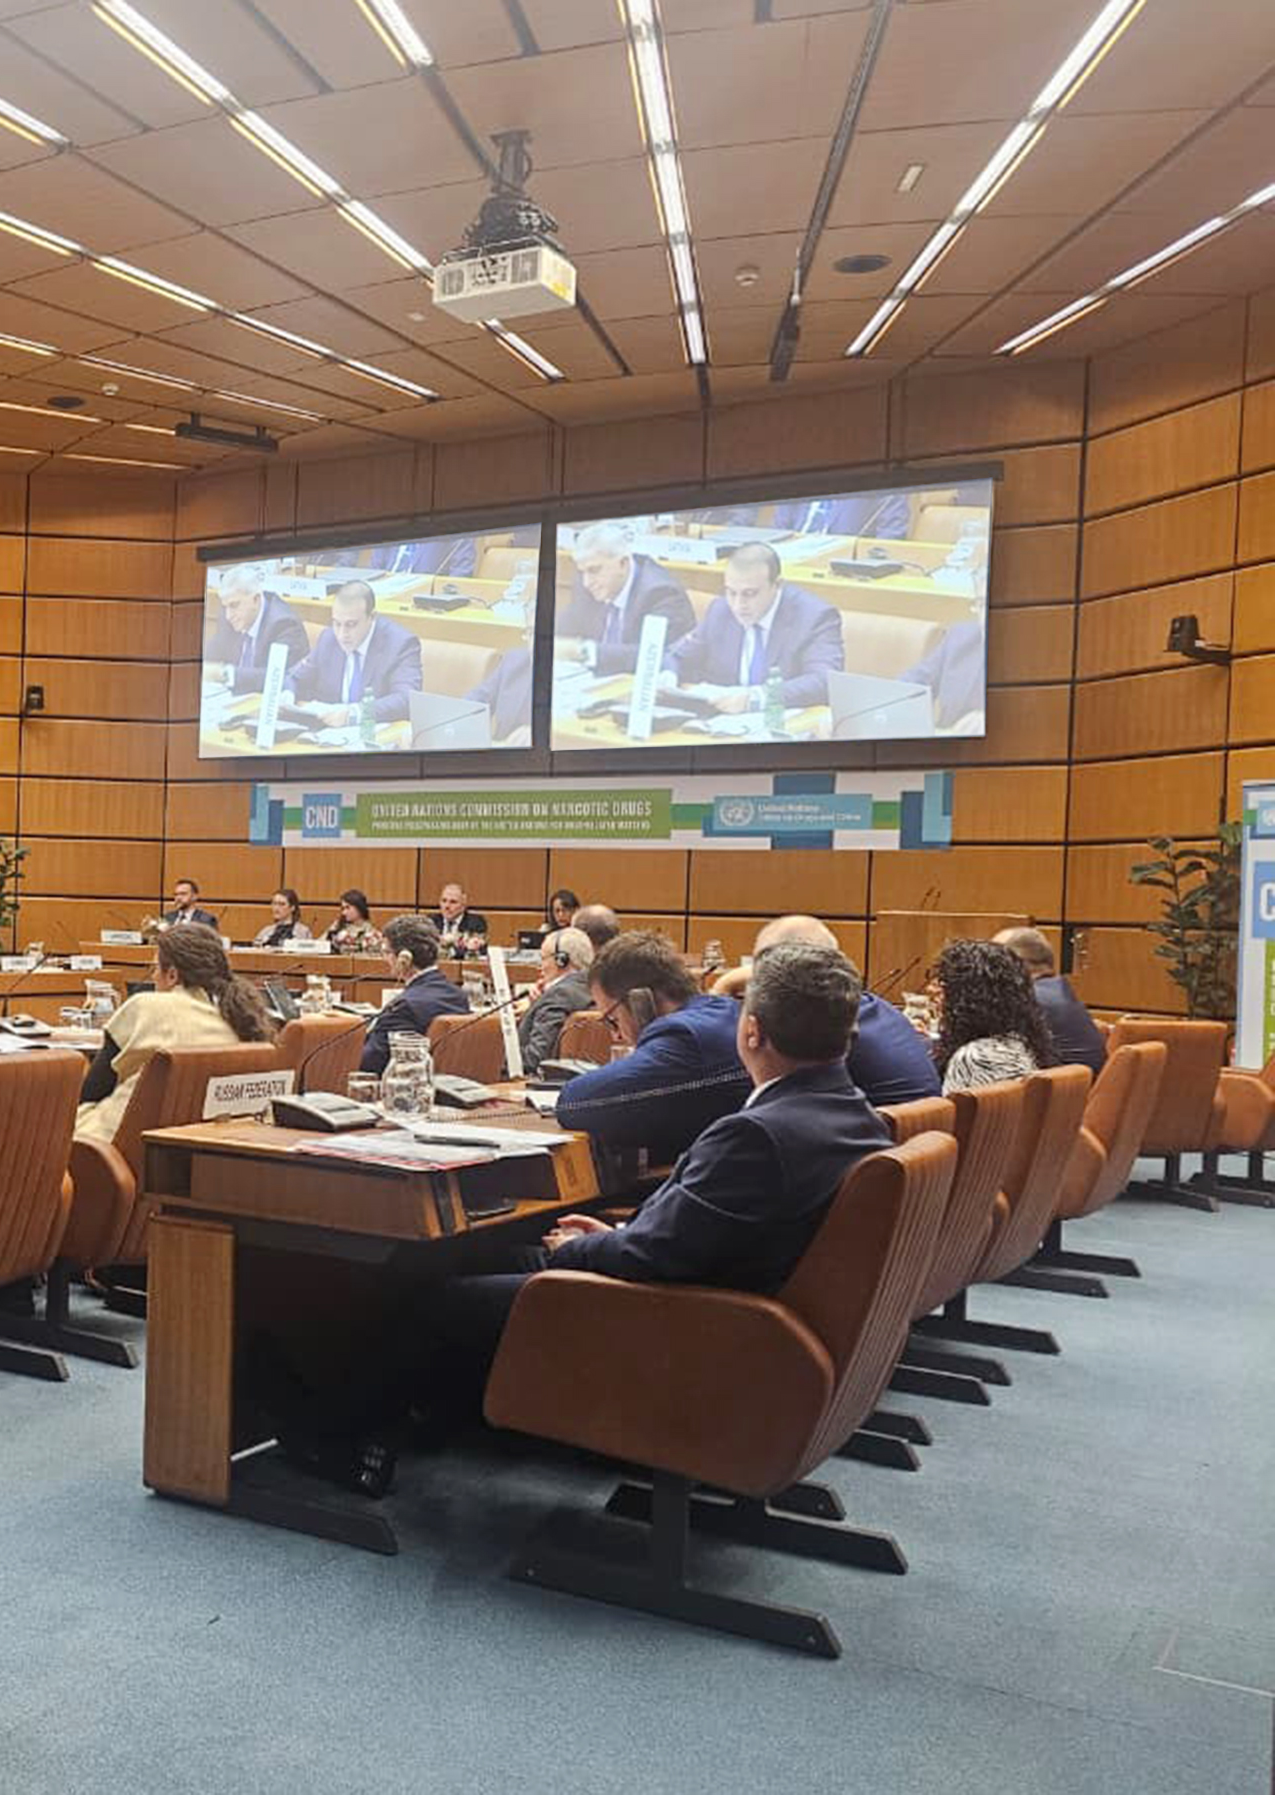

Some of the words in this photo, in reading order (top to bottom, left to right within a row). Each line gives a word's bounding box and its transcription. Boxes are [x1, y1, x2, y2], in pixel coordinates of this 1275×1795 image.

[305, 804, 339, 829] CND
[371, 803, 409, 818] UNITED
[411, 803, 457, 817] NATIONS
[460, 802, 530, 817] COMMISSION
[532, 802, 549, 816] ON
[551, 801, 610, 816] NARCOTIC
[612, 800, 652, 816] DRUGS
[214, 1083, 244, 1101] RUSSIAN
[245, 1079, 286, 1099] FEDERATION
